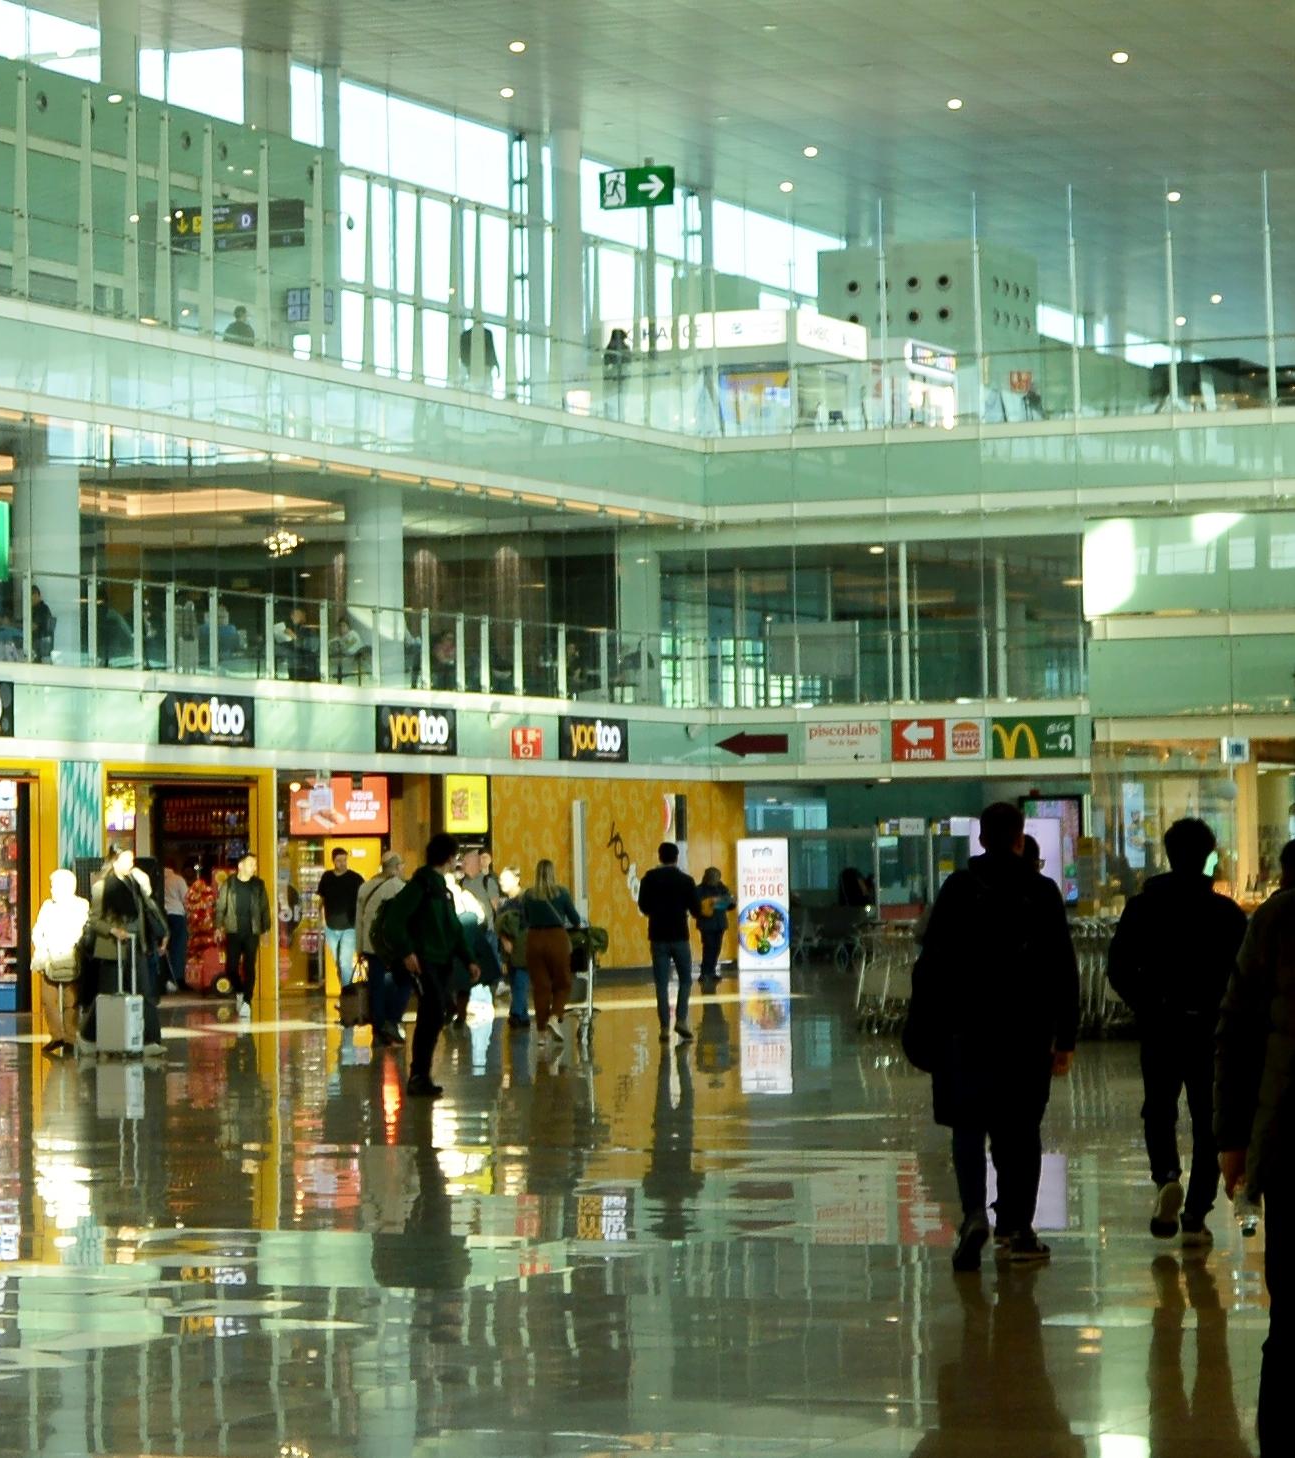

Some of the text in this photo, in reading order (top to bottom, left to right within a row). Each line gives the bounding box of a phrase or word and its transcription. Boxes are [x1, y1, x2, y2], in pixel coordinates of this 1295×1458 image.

[241, 213, 251, 227] D
[174, 696, 245, 740] yootoo
[388, 709, 449, 750] yootoo
[808, 723, 880, 740] piscolabis
[570, 719, 621, 757] yootoo
[952, 738, 980, 750] KING
